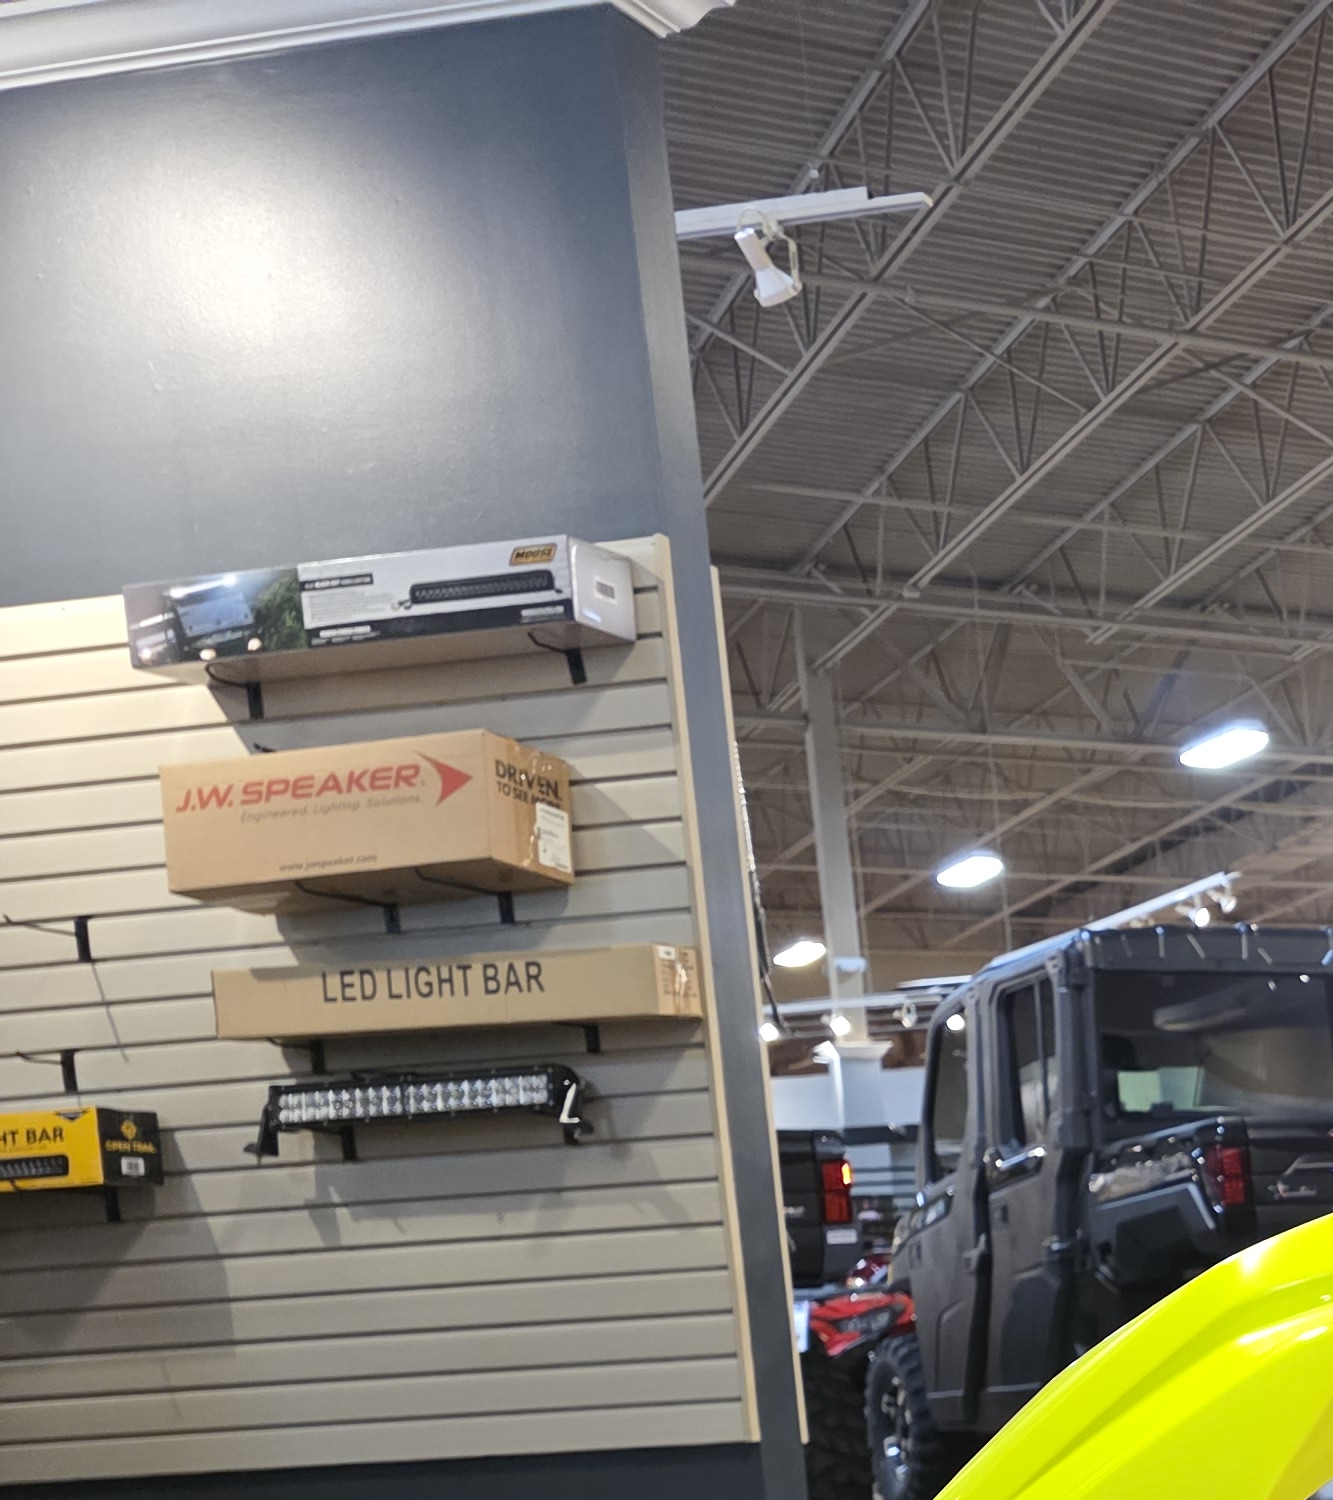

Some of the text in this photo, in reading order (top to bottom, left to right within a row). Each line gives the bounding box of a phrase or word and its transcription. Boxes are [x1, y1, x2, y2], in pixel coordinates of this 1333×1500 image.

[514, 547, 553, 560] MOOSE
[175, 763, 421, 813] J.W. SPEAKER
[321, 961, 545, 1003] LED LIGHT BAR
[26, 1127, 64, 1145] BAR
